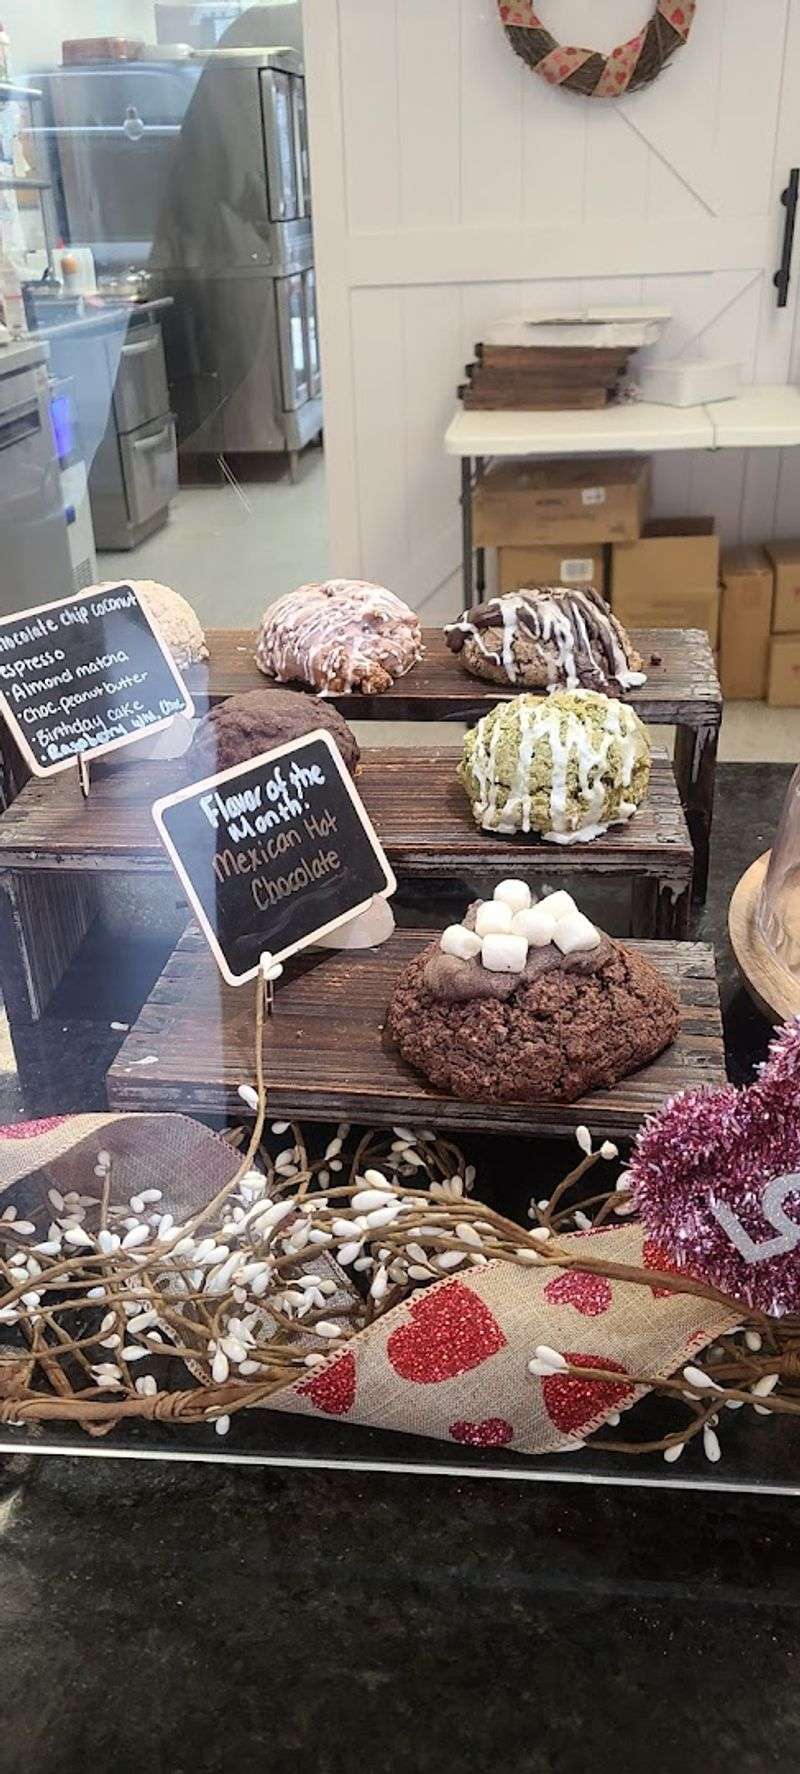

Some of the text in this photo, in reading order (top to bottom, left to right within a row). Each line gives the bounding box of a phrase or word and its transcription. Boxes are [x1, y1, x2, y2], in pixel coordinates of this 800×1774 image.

[11, 650, 129, 702] Almond matcha
[35, 714, 106, 747] Birthday
[200, 761, 325, 828] Flavor of the
[212, 809, 338, 883] Mexican Hot
[251, 849, 341, 911] Chocolate
